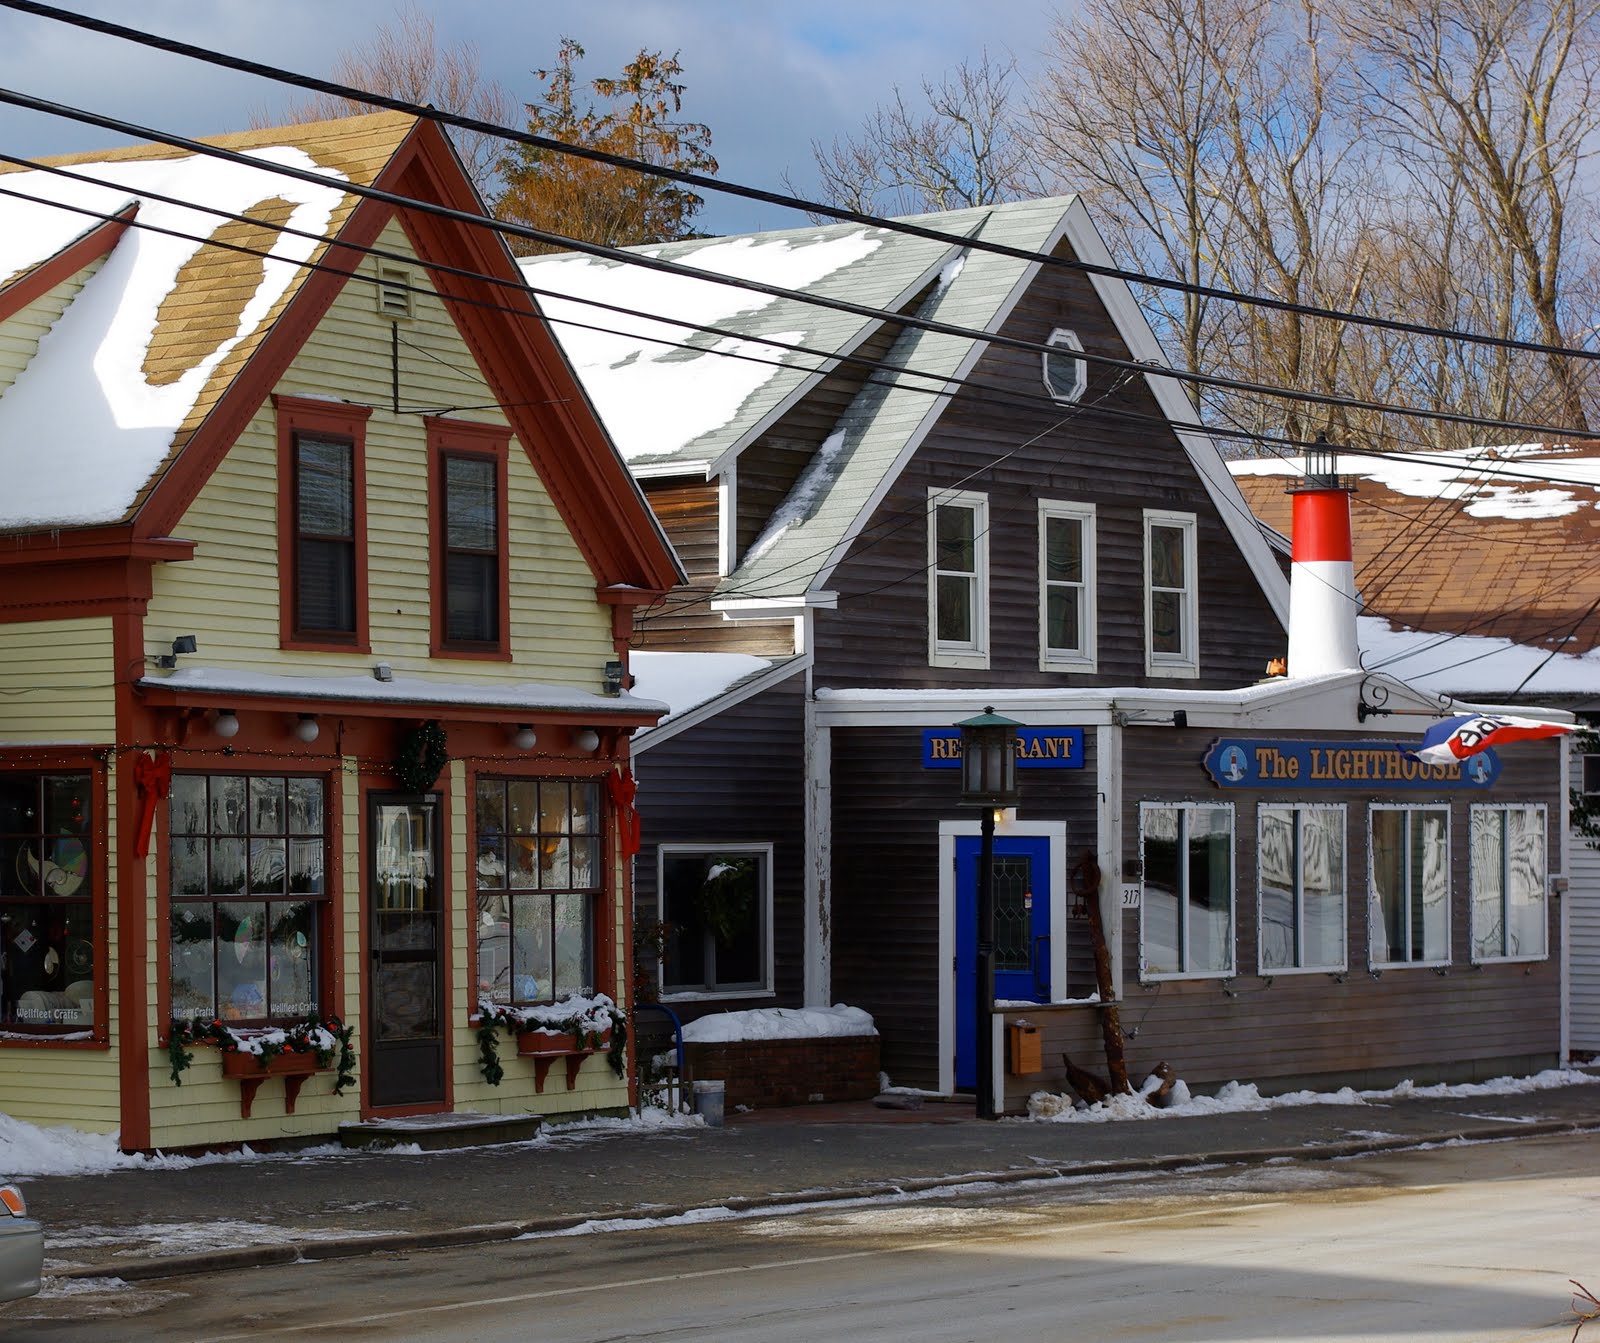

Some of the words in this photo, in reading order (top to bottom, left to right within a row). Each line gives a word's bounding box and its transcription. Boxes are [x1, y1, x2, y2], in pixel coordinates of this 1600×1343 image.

[931, 737, 1073, 759] RERANT
[1255, 748, 1300, 780] The
[1123, 889, 1139, 904] 317
[16, 1008, 52, 1019] Wellfleet
[53, 1008, 79, 1020] Crafts
[299, 1001, 318, 1012] Crafts
